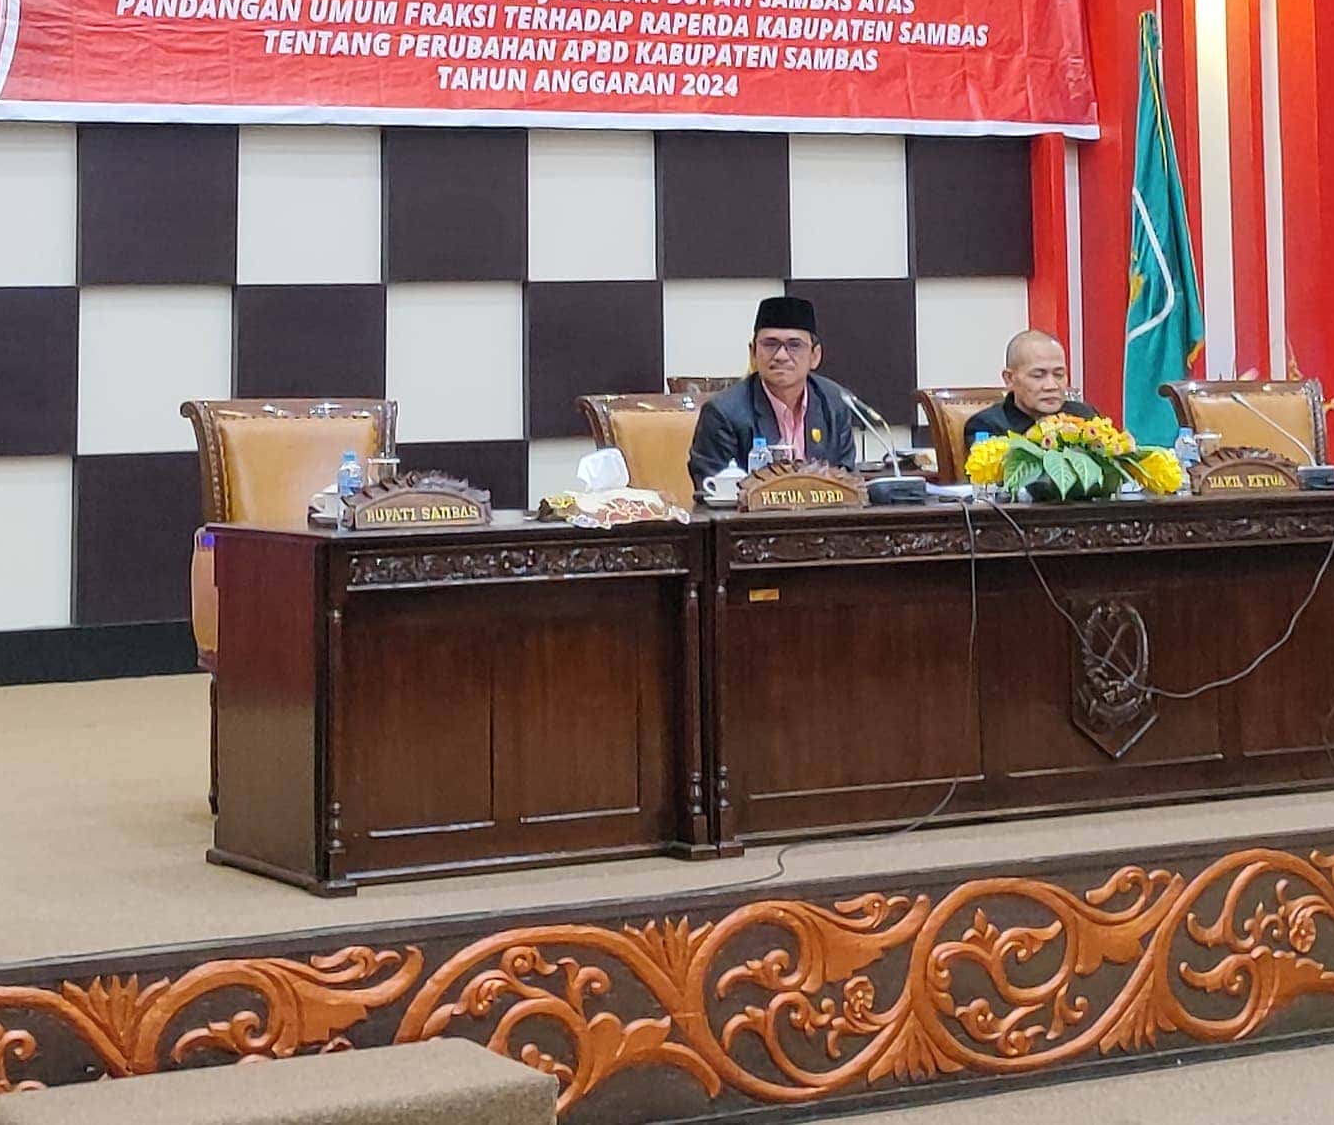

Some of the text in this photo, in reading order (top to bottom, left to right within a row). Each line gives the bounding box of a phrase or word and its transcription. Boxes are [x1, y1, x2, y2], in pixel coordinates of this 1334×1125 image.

[404, 2, 497, 28] FRAKSI
[503, 6, 633, 33] TERHADAP
[639, 11, 749, 37] RAPERDA
[756, 15, 893, 43] KABUPATEN
[898, 22, 989, 47] SAMBAS
[264, 29, 878, 71] TENTANG PERUBAHAN APBD KABUPATEN SAMBAS
[437, 65, 739, 97] TAHUN ANGGARAN 2024
[1248, 473, 1287, 487] KETUA
[761, 489, 844, 506] KETUA DPRD
[367, 504, 479, 523] BUPATI SAMBAS
